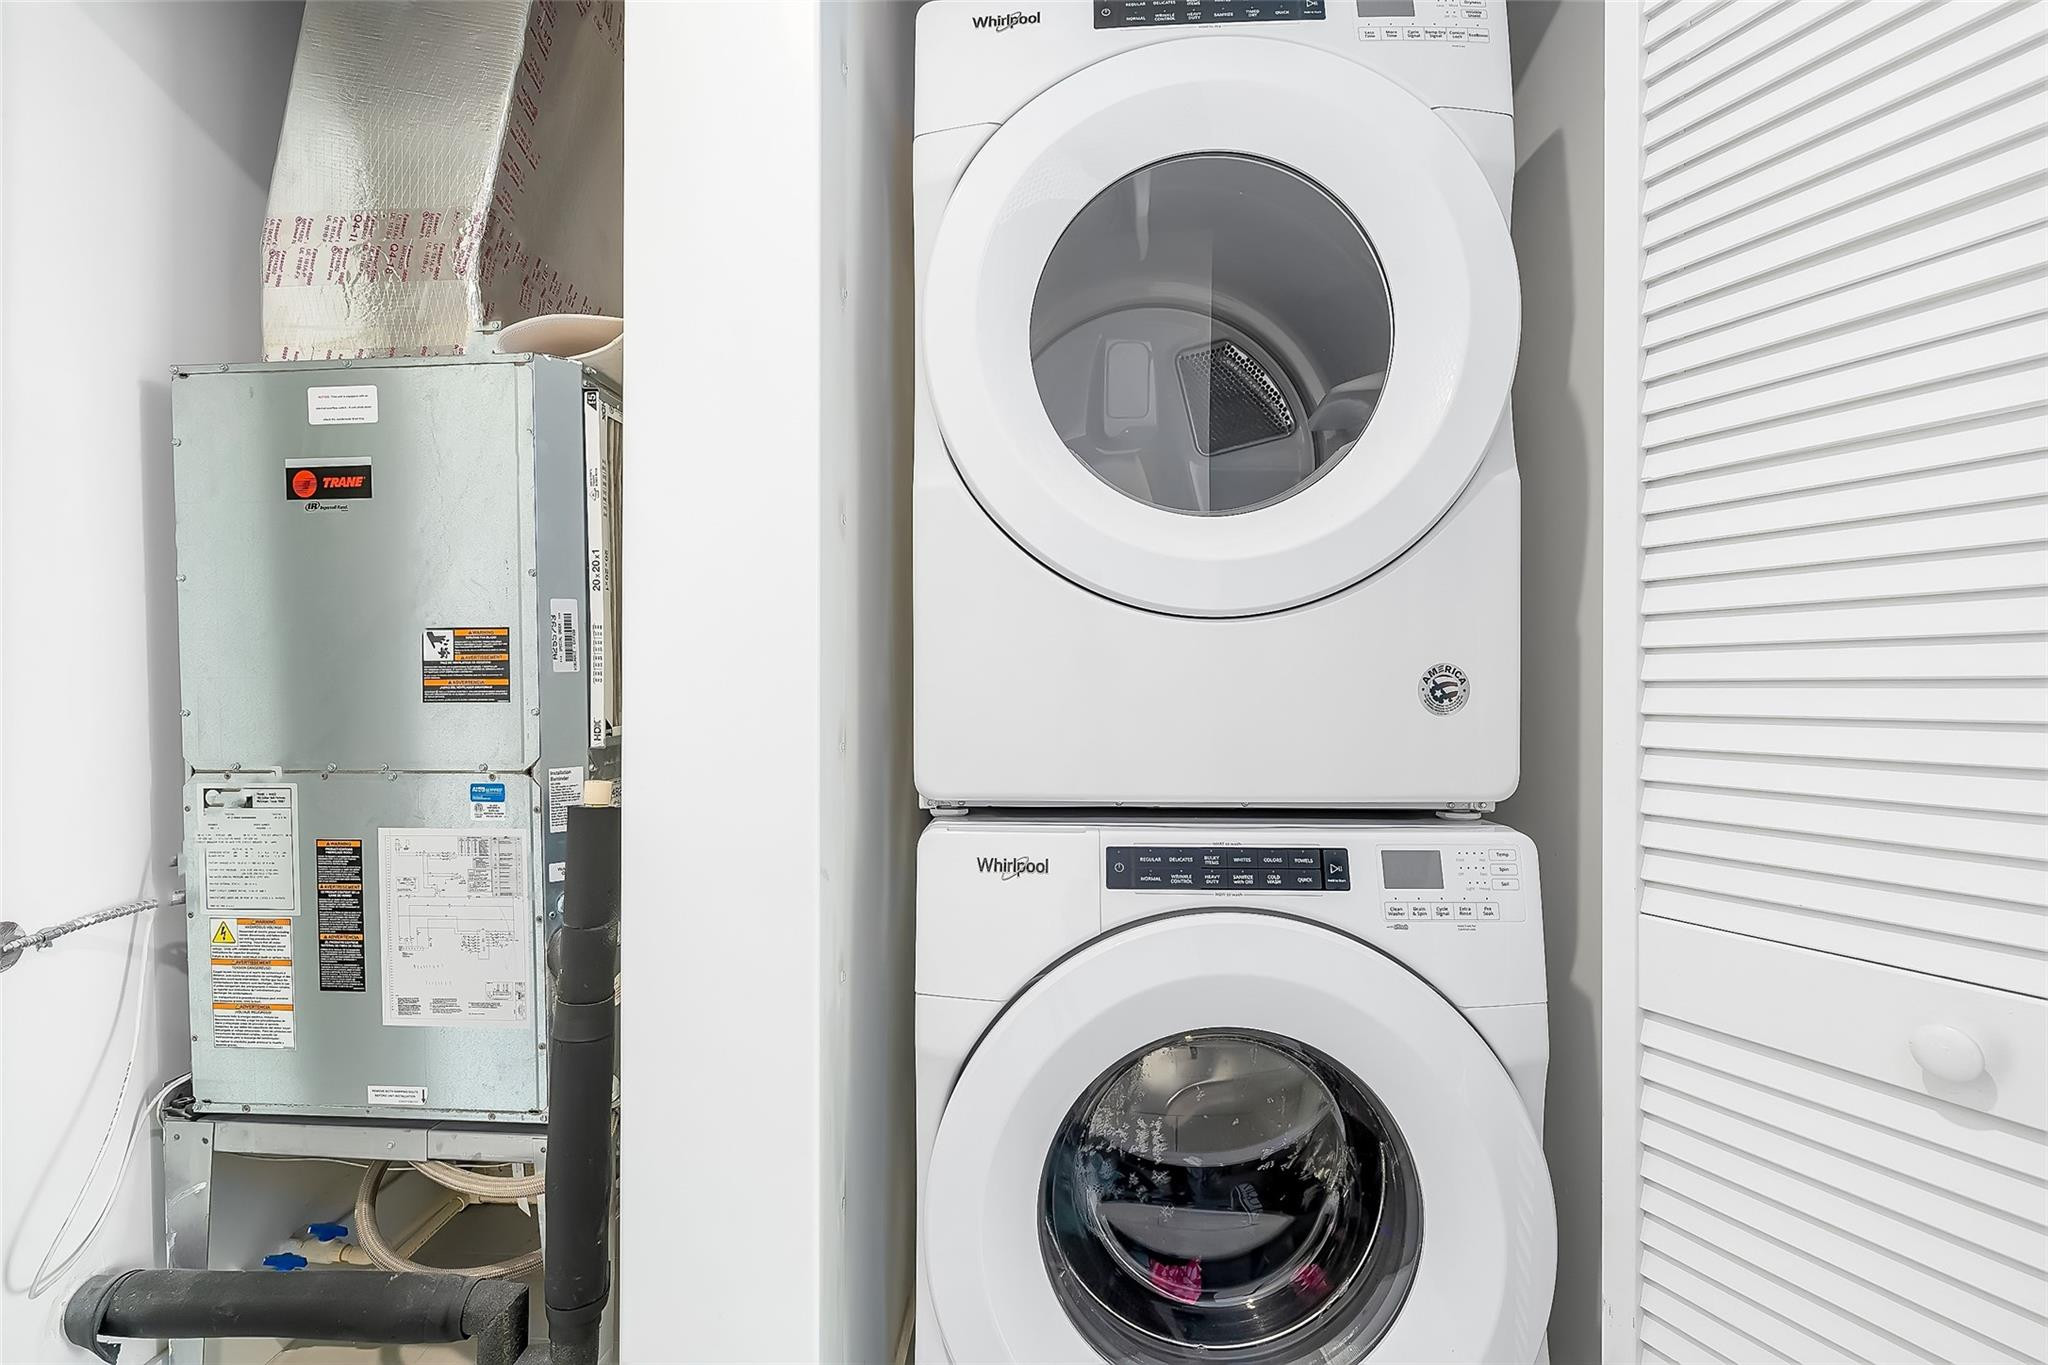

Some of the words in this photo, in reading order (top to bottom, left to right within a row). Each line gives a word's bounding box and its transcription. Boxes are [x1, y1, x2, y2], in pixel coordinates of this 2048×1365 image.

[972, 12, 1041, 30] Whirlpool
[385, 244, 398, 274] Q4-18
[323, 476, 363, 488] TRANE
[1423, 664, 1466, 685] AMERICA
[593, 720, 602, 740] HDX
[976, 856, 1048, 880] Whirlpool
